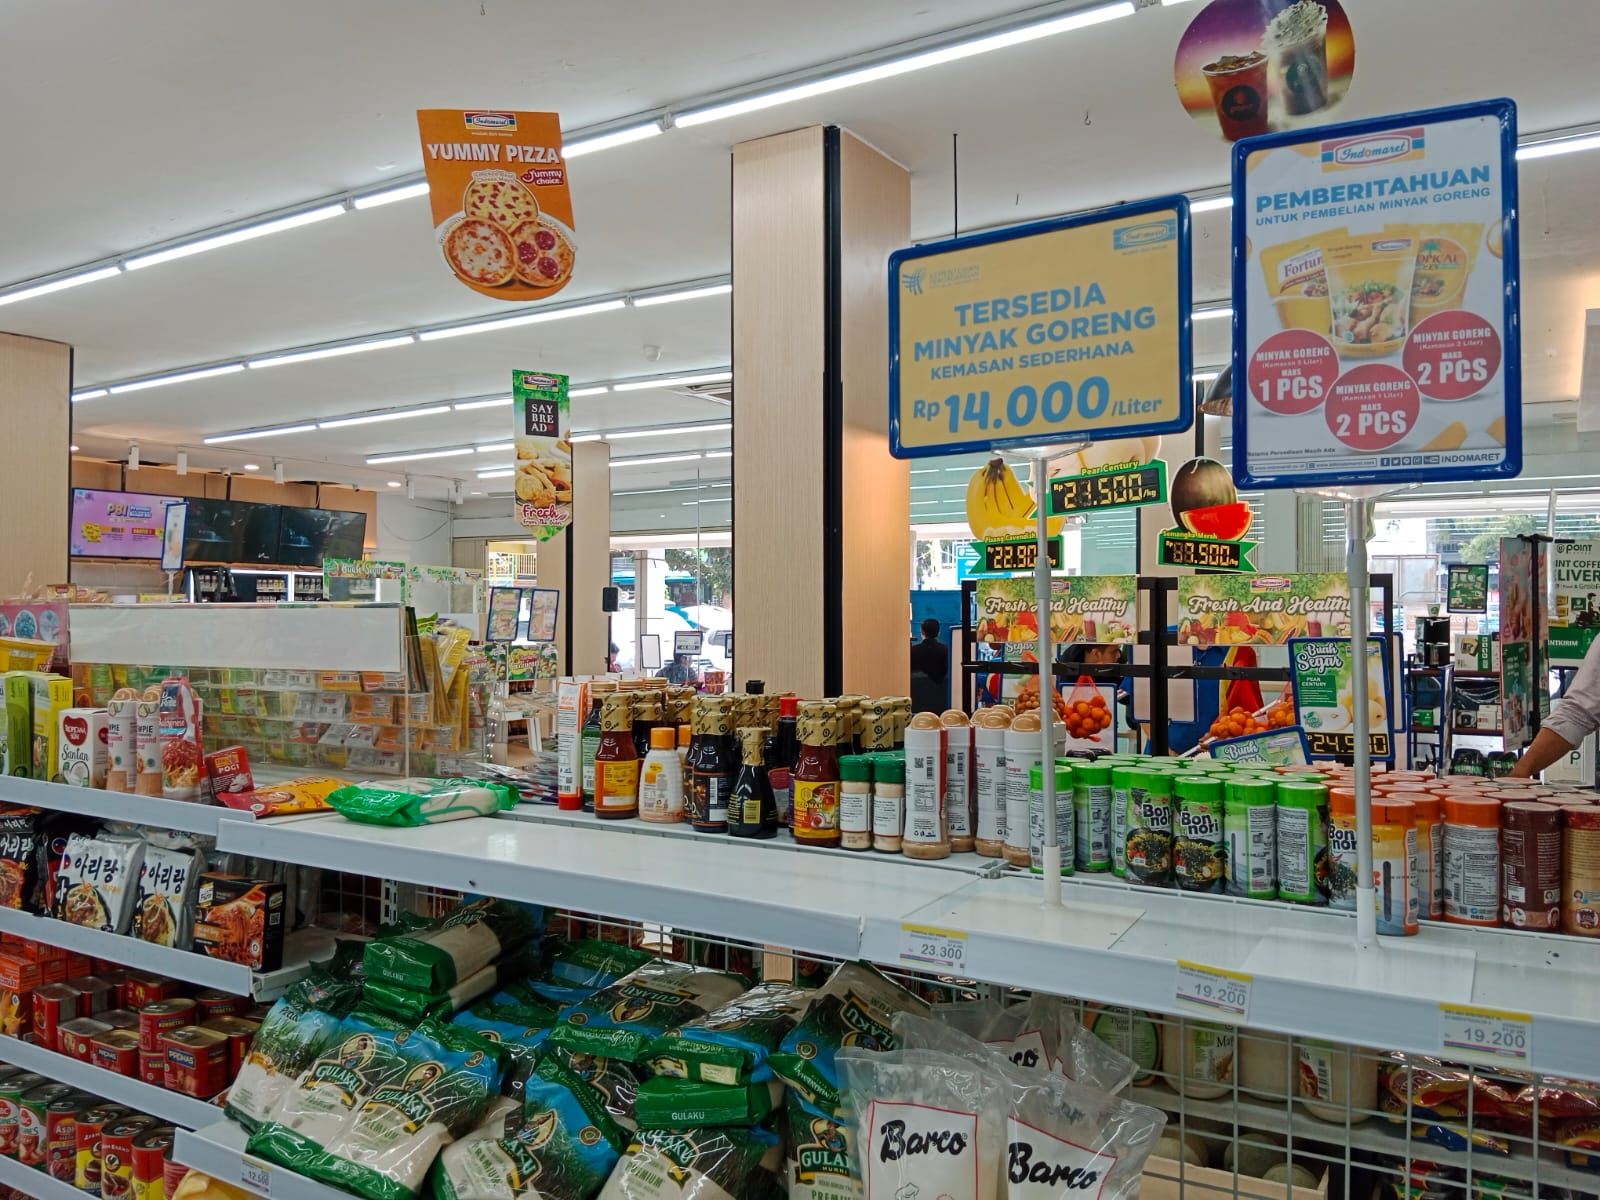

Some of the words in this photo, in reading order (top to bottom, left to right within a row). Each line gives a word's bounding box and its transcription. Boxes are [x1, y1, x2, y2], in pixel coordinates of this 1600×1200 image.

[427, 144, 500, 162] YUMMY
[506, 145, 560, 164] PIZZA
[1339, 140, 1406, 161] Indomaret
[1256, 165, 1490, 213] PEMBERITAHUAN
[1256, 212, 1299, 226] UNTUK
[1302, 202, 1375, 220] PEMBELIAN
[1379, 195, 1428, 211] MINYAK
[1433, 187, 1491, 204] GORENG
[955, 281, 1106, 326] TERSEDIA
[914, 326, 1018, 362] MINYAK
[1026, 306, 1156, 345] GORENG
[1413, 331, 1450, 343] MINYAK
[1452, 328, 1491, 340] GORENG
[931, 356, 1014, 380] KEMASAN
[1019, 340, 1135, 369] SEDERHANA
[1256, 350, 1291, 362] MINYAK
[1293, 346, 1330, 358] GORENG
[1281, 368, 1302, 376] MAKS
[1417, 363, 1432, 385] 2
[1440, 358, 1488, 384] PCS
[1259, 381, 1270, 401] 1
[1277, 375, 1323, 400] PCS
[1336, 383, 1371, 395] MINYAK
[1373, 380, 1411, 392] GORENG
[531, 403, 553, 414] SAY
[913, 399, 940, 421] Rp
[944, 376, 1110, 433] 14.000
[1111, 397, 1163, 418] /Liter
[531, 413, 554, 423] BRE
[531, 422, 548, 432] AD
[1336, 414, 1351, 437] 2
[1358, 411, 1407, 435] PCS
[1441, 453, 1500, 464] INDOMARET
[1081, 466, 1100, 476] Pear
[1102, 460, 1139, 473] Century
[1053, 484, 1063, 492] Rp
[1143, 488, 1157, 498] /kg
[523, 504, 559, 519] Fresh
[994, 545, 1037, 569] 22.90
[1555, 560, 1571, 568] INT
[1573, 560, 1600, 569] COFFE
[985, 596, 1027, 615] Fresh
[1067, 596, 1128, 616] Healthy
[1188, 595, 1239, 614] Fresh
[1243, 596, 1284, 613] And
[1307, 642, 1338, 657] Buah
[1297, 652, 1343, 674] Segar
[62, 743, 89, 761] Santan
[1224, 739, 1260, 760] Buah
[1142, 803, 1170, 818] Bon
[1181, 812, 1212, 826] Bon
[1187, 818, 1218, 835] nori
[1329, 825, 1355, 841] Bon
[1332, 840, 1357, 850] nor
[74, 854, 118, 883] 아리랑
[148, 862, 185, 894] 아리랑
[921, 943, 962, 960] 23.300
[1194, 983, 1246, 1006] 19.200
[1464, 1028, 1526, 1049] 19.200
[672, 1111, 705, 1120] GULAKU
[880, 1119, 967, 1163] Barco
[801, 1151, 848, 1168] GULA
[1008, 1142, 1097, 1189] Barco
